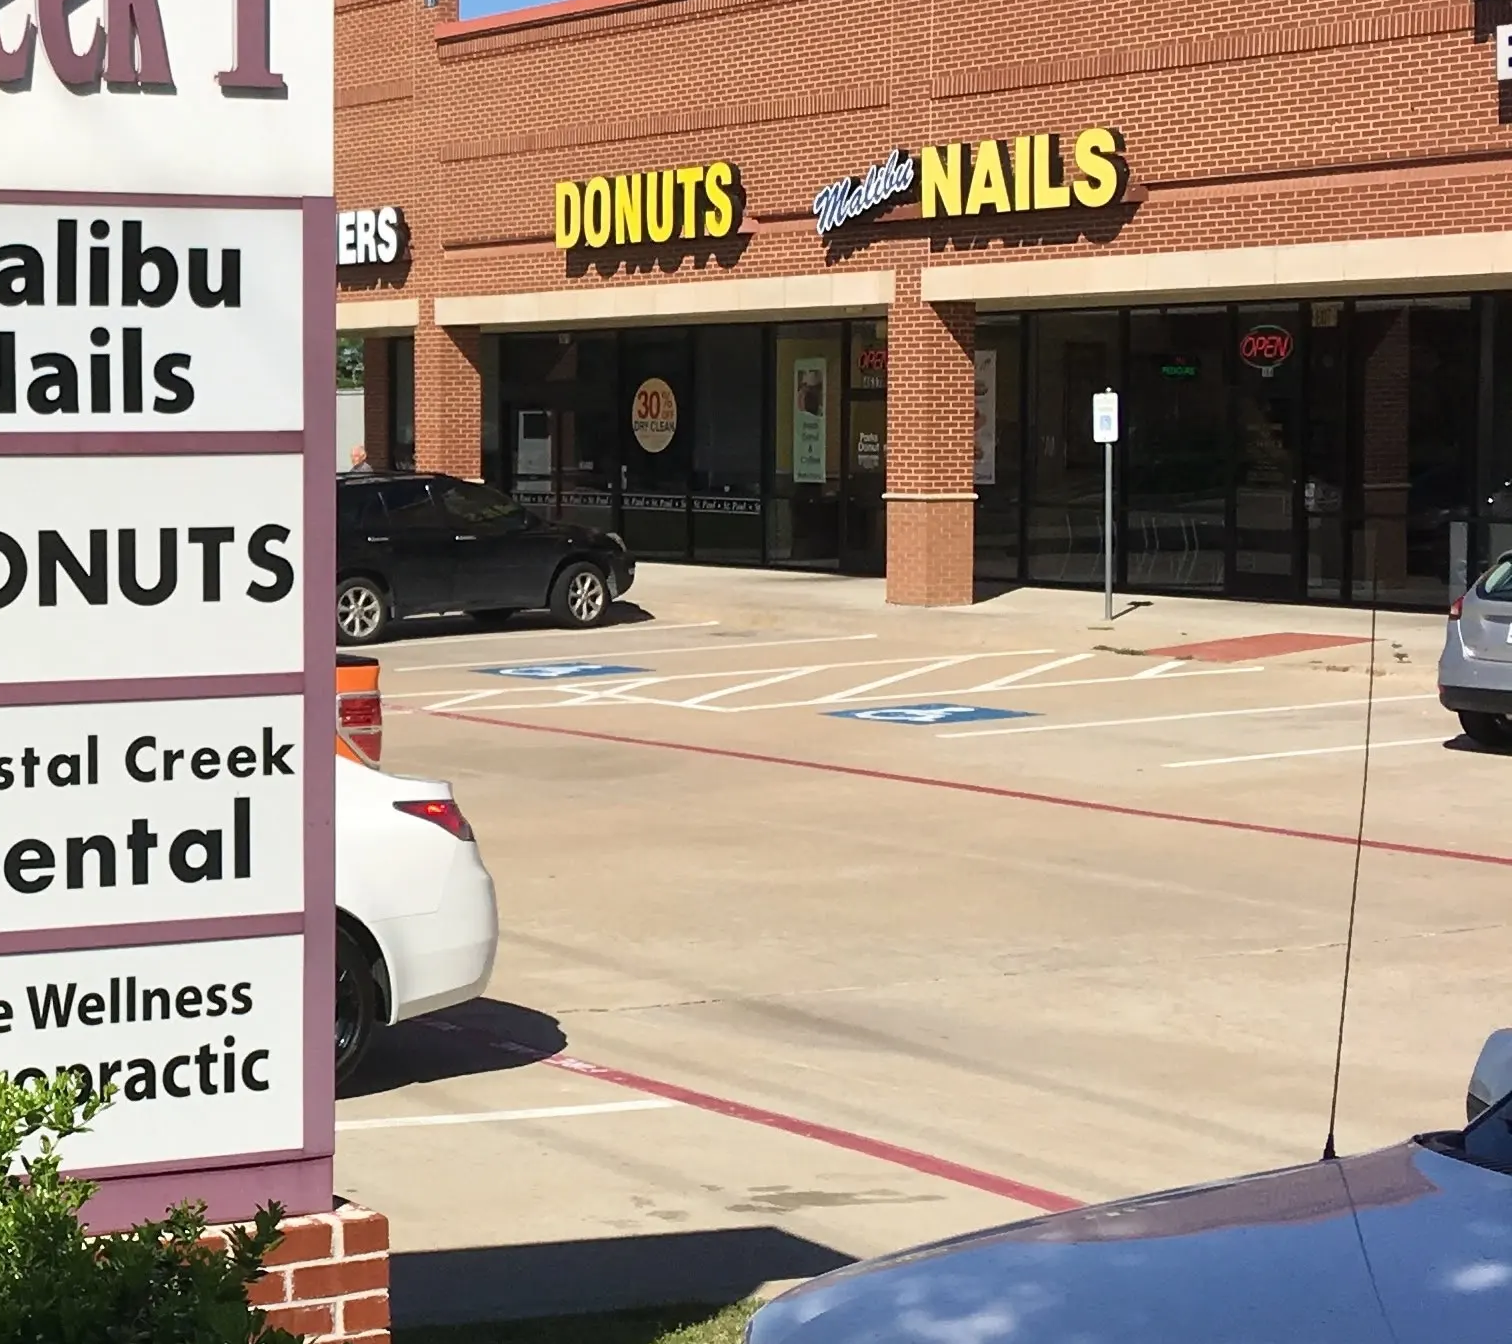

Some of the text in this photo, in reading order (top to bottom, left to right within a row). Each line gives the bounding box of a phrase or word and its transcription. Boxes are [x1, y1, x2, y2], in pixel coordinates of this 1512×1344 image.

[556, 162, 733, 248] DONUTS
[813, 128, 1117, 235] Malibu NAILS
[336, 207, 397, 264] ERS
[1242, 336, 1290, 358] OPEN
[126, 726, 296, 783] Creek
[26, 976, 253, 1030] Wellness
